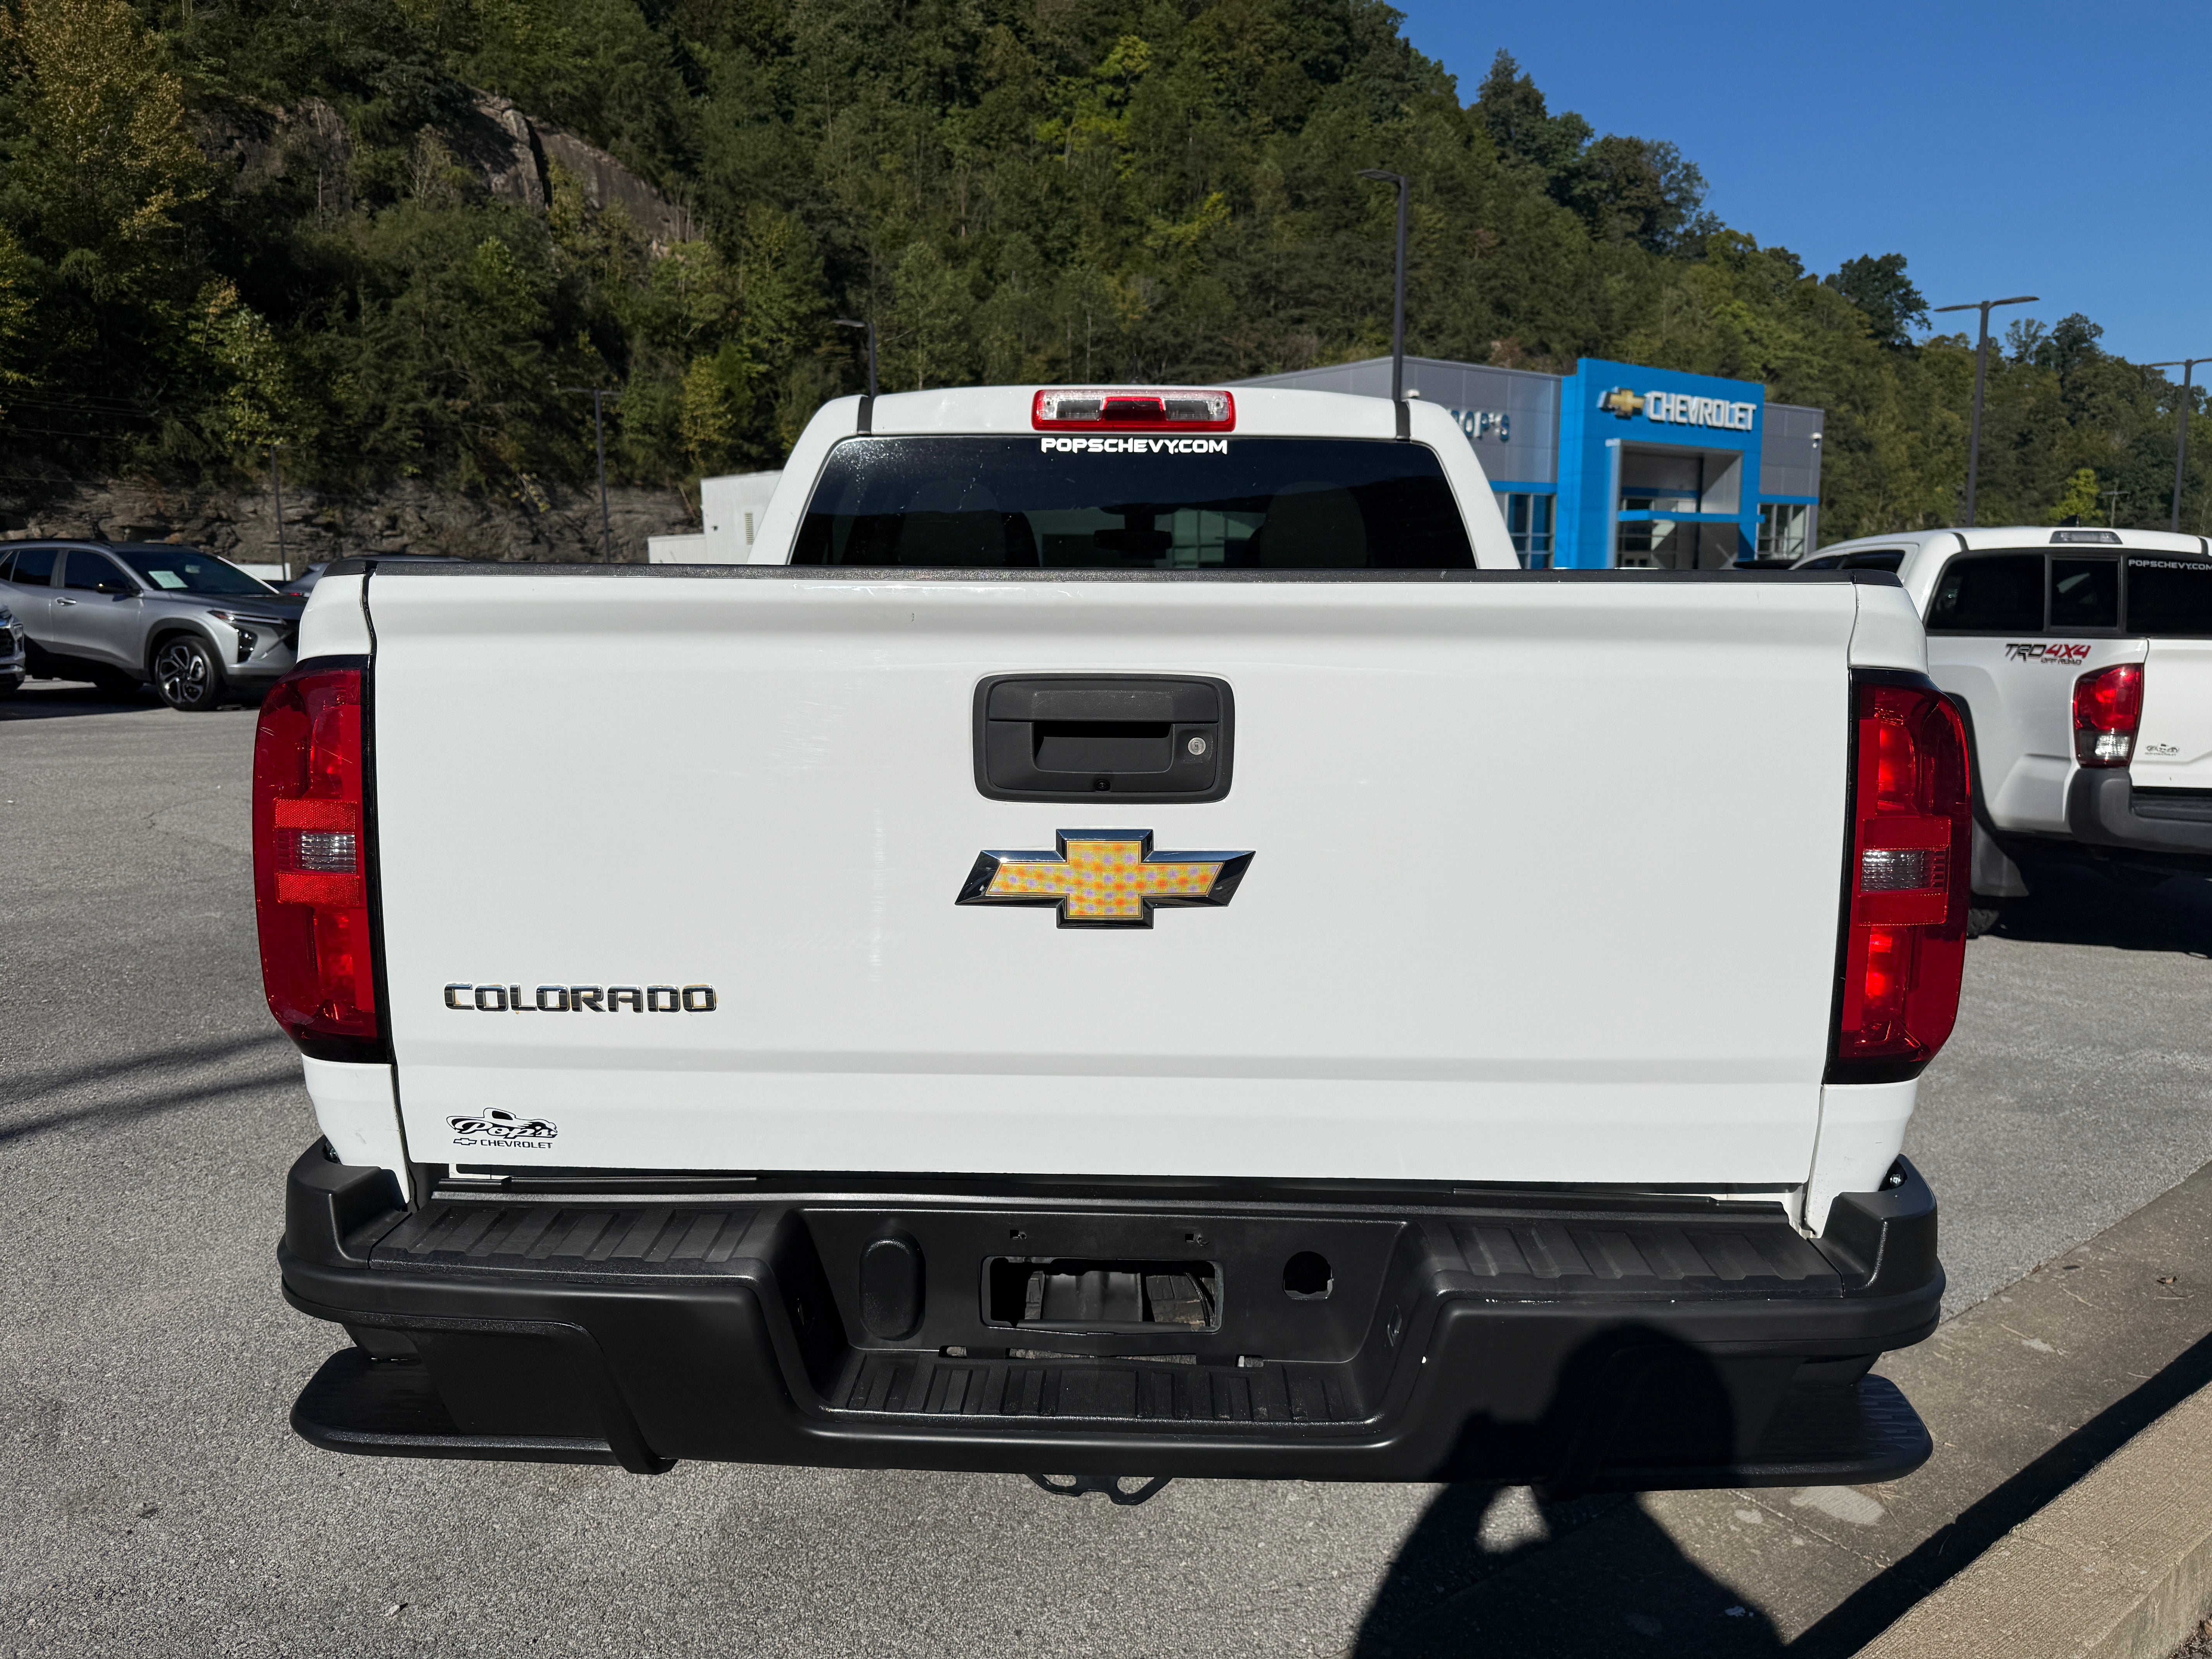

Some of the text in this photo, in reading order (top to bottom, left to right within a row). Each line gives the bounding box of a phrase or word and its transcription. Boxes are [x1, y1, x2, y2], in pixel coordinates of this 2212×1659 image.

[1645, 390, 1757, 431] CHEVROLET
[1041, 437, 1228, 455] POPSCHEVY.COM
[2128, 559, 2212, 570] POPSCHEVY.COM
[444, 982, 717, 1013] COLORADO
[452, 1119, 555, 1139] Pop's
[480, 1139, 553, 1149] CHEVROLET
